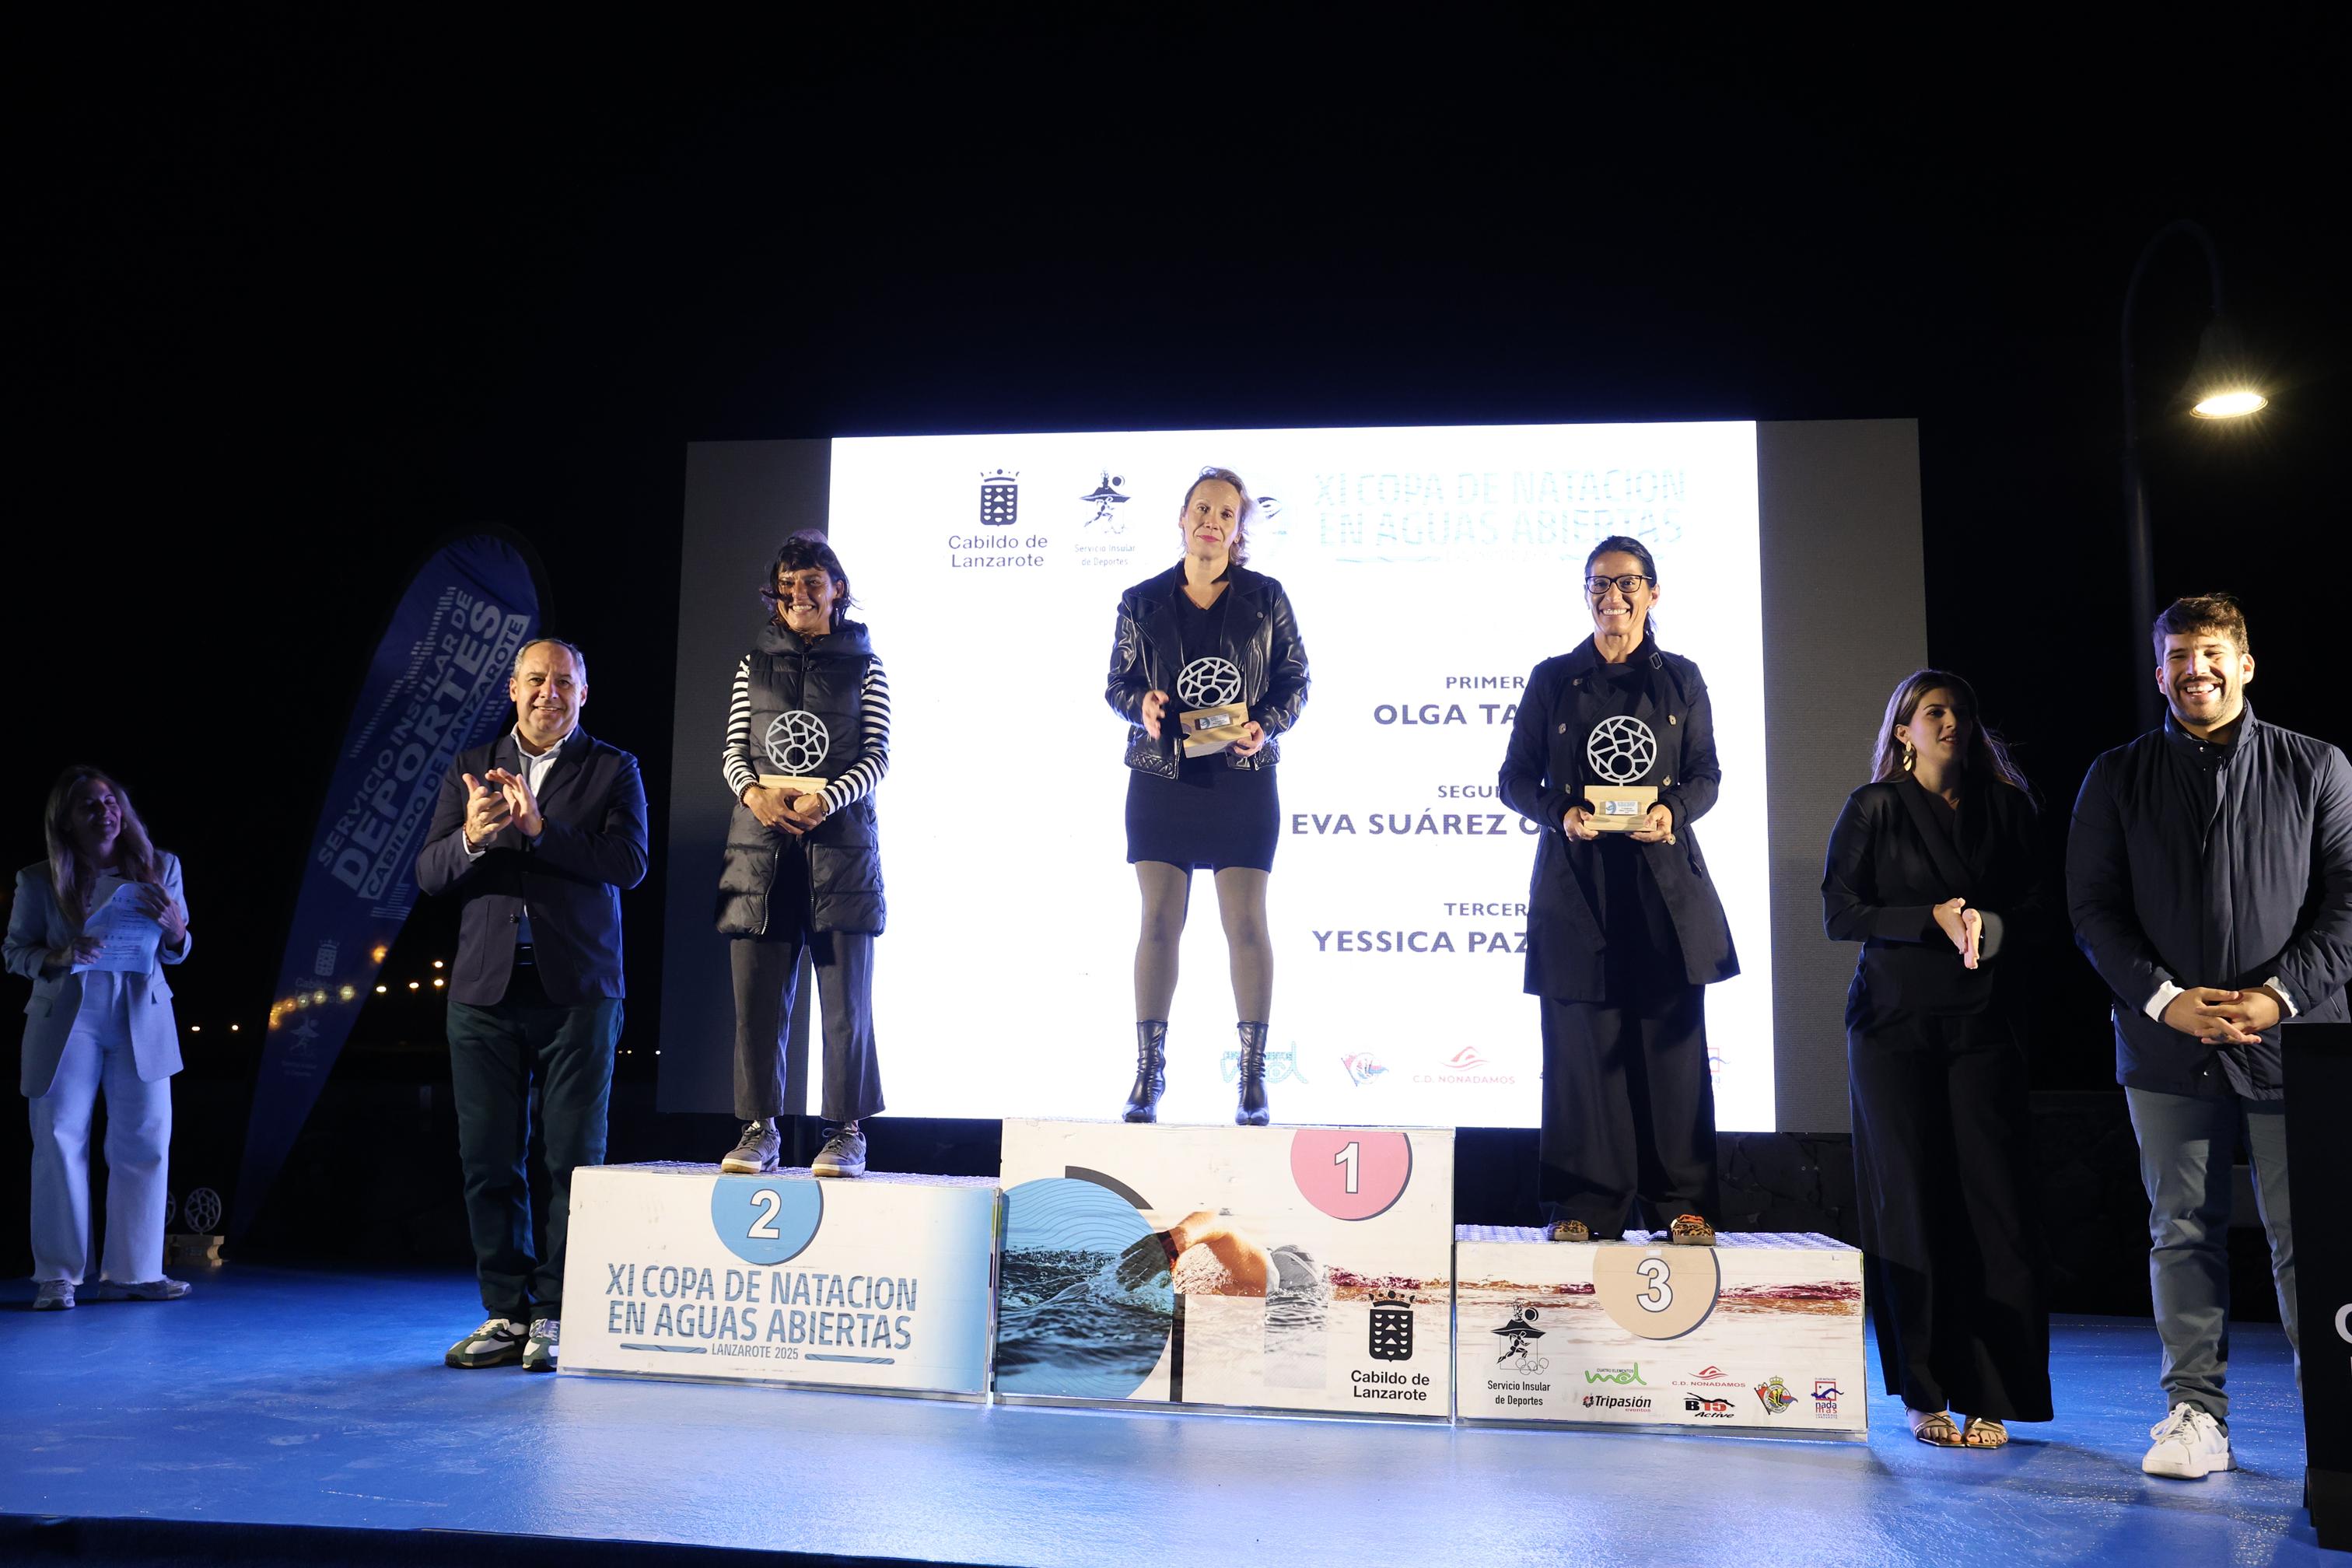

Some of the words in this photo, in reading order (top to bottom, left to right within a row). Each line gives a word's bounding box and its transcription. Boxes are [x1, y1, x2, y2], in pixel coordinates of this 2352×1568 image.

[1357, 472, 1444, 506] COPA
[1456, 471, 1500, 506] DE
[1320, 511, 1363, 546] EN
[1376, 509, 1500, 546] AGUAS
[1511, 509, 1682, 544] ABIERTAS
[948, 534, 1019, 549] Cabildo
[1025, 534, 1048, 548] de
[1074, 544, 1106, 552] Servicio
[952, 553, 1044, 567] Lanzarote
[1081, 558, 1090, 566] de
[1094, 557, 1129, 567] Deportes
[1374, 704, 1468, 725] OLGA
[317, 749, 394, 868] SERVICIO
[391, 632, 459, 747] INSULAR
[450, 589, 475, 631] DE
[331, 600, 502, 891] DEPORTES
[366, 795, 427, 898] CABILDO
[422, 757, 449, 792] DE
[442, 616, 526, 758] LANZAROTE
[1437, 785, 1500, 798] SEGU
[1292, 814, 1356, 835] EVA
[1368, 807, 1507, 835] SUÁREZ
[1311, 930, 1456, 953] YESSICA
[1468, 932, 1527, 953] PAZ
[1438, 1075, 1516, 1084] NONADAMOS
[1334, 1141, 1360, 1194] 1
[747, 1188, 782, 1240] 2
[606, 1263, 635, 1297] XI
[642, 1265, 715, 1300] COPA
[726, 1269, 761, 1304] DE
[771, 1271, 918, 1312] NATACION
[1636, 1258, 1674, 1313] 3
[608, 1300, 646, 1335] EN
[654, 1303, 757, 1342] AGUAS
[766, 1309, 912, 1351] ABIERTAS
[712, 1343, 772, 1360] LANZAROTE
[775, 1346, 799, 1360] 2025
[1350, 1369, 1407, 1385] Cabildo
[1411, 1372, 1430, 1386] de
[1487, 1380, 1520, 1391] Servicio
[1522, 1381, 1551, 1391] Insular
[1353, 1385, 1427, 1402] Lanzarote
[1495, 1395, 1505, 1404] de
[1507, 1395, 1543, 1407] Deportes
[1595, 1395, 1652, 1409] Tripasión
[1685, 1400, 1727, 1412] B15
[1815, 1400, 1837, 1409] nada
